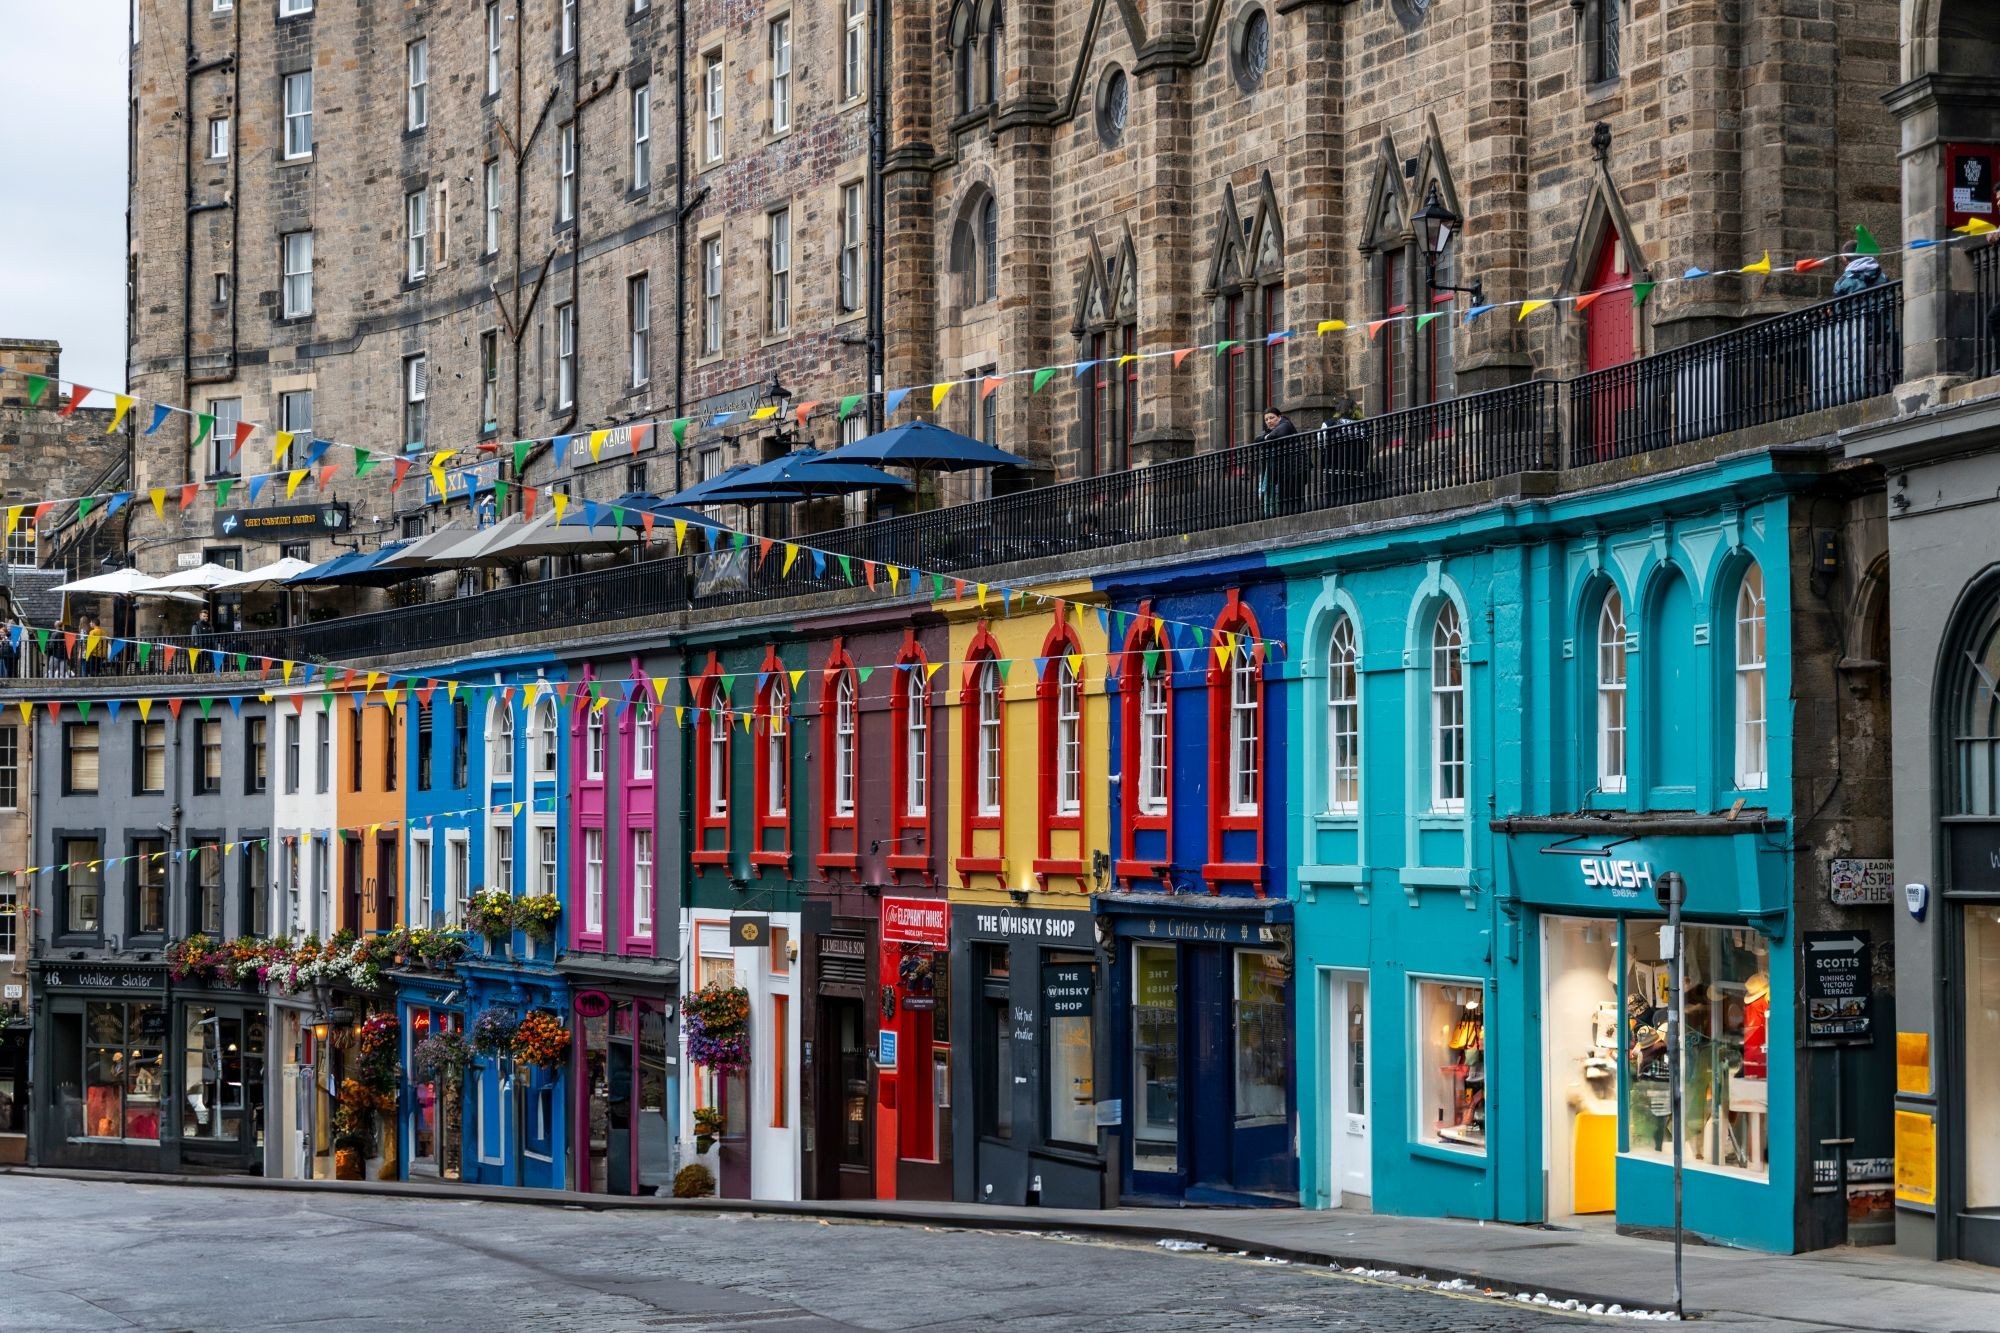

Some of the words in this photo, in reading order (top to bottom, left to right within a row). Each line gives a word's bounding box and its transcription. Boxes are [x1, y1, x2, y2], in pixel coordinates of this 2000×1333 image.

[428, 466, 483, 496] MXIS
[1580, 858, 1652, 889] SWISH
[364, 877, 377, 914] 40
[885, 904, 900, 926] The
[898, 907, 925, 927] ELEPHANT
[925, 909, 943, 928] HOUSE
[977, 915, 998, 932] THE
[1001, 915, 1042, 935] WHISKY
[1045, 918, 1075, 937] SHOP
[1203, 920, 1227, 940] Sark
[1816, 958, 1860, 969] SCOTTS
[43, 971, 63, 985] 46.
[79, 973, 115, 986] Walker
[121, 974, 153, 987] Slater
[1058, 973, 1079, 981] THE
[1822, 981, 1854, 989] VICTORIA
[1048, 987, 1090, 996] WHISKY
[1823, 988, 1854, 996] TERRACE
[1054, 1002, 1083, 1011] SHOP
